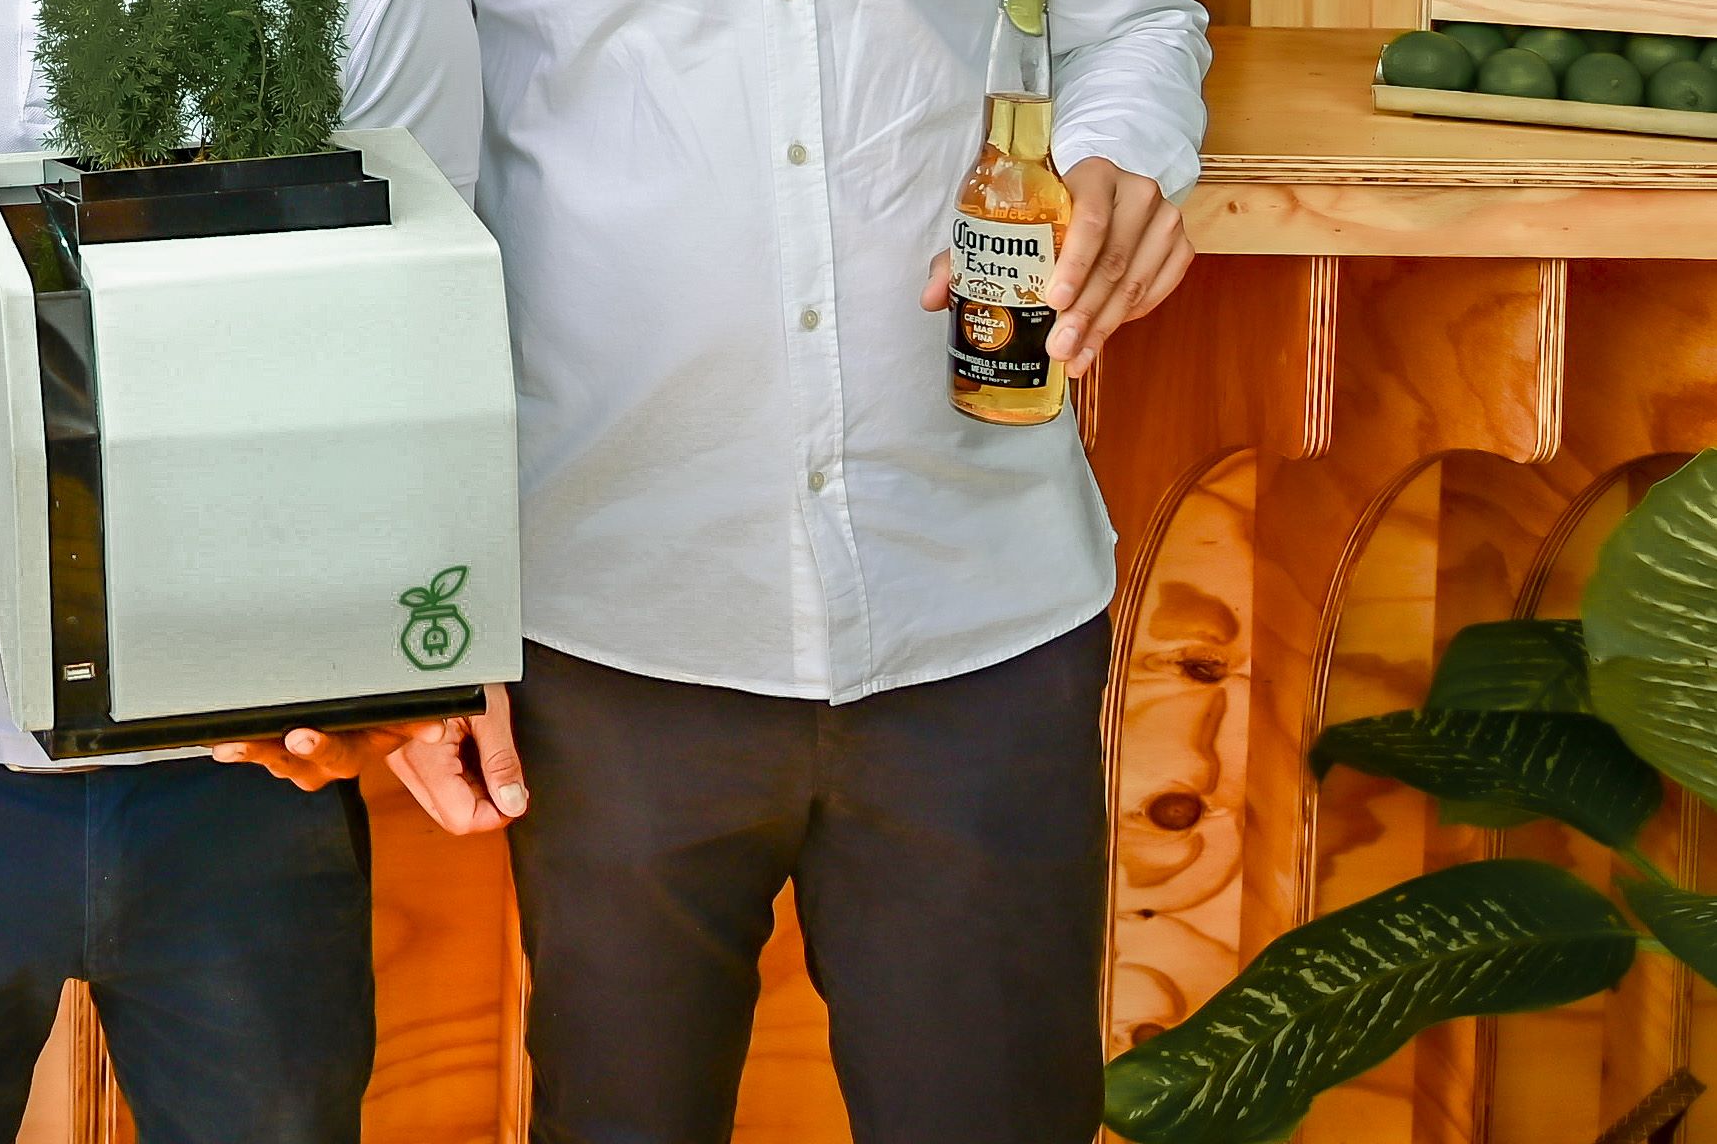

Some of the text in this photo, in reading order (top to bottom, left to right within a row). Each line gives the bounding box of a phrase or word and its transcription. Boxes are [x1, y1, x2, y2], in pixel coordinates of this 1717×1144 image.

[965, 250, 1019, 279] Extra
[977, 308, 990, 318] LA
[964, 313, 1006, 329] CERVEZA
[972, 332, 993, 344] FINA
